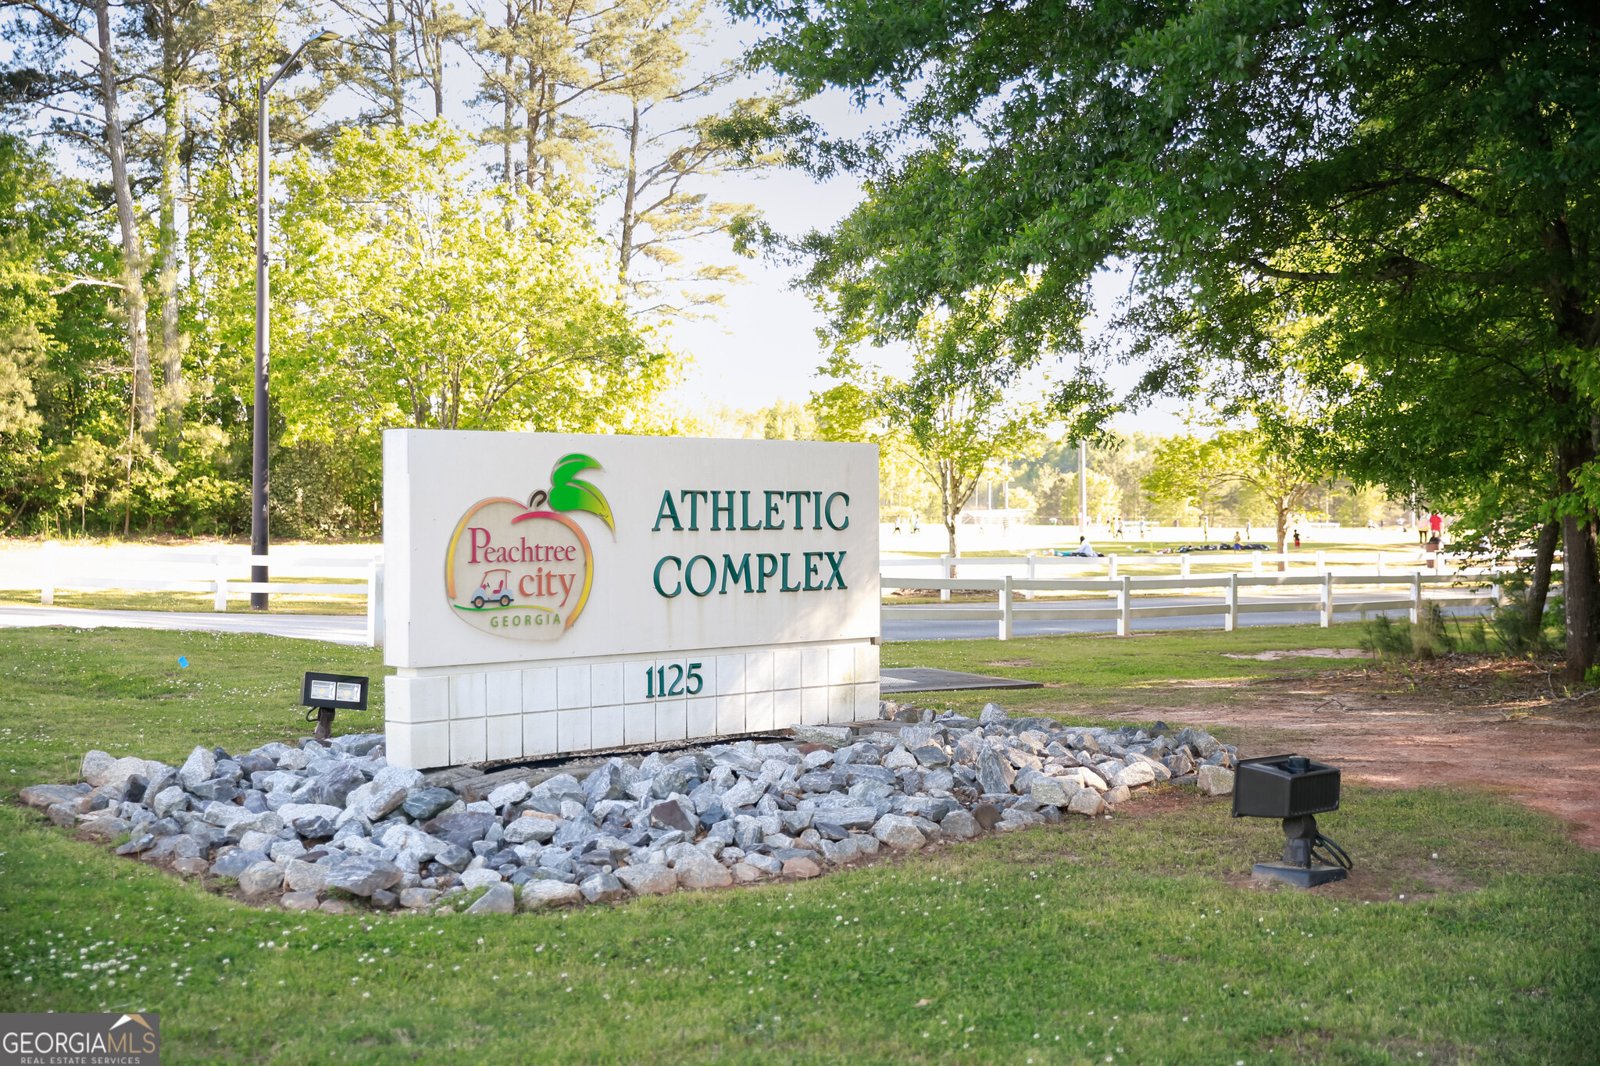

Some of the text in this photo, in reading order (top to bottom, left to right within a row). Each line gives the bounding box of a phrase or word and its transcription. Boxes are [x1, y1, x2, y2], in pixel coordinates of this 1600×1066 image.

[651, 489, 850, 532] ATHLETIC
[467, 527, 577, 564] Peachtree
[518, 567, 577, 608] city
[653, 551, 848, 599] COMPLEX
[490, 613, 561, 628] GEORGIA
[645, 662, 704, 699] 1125
